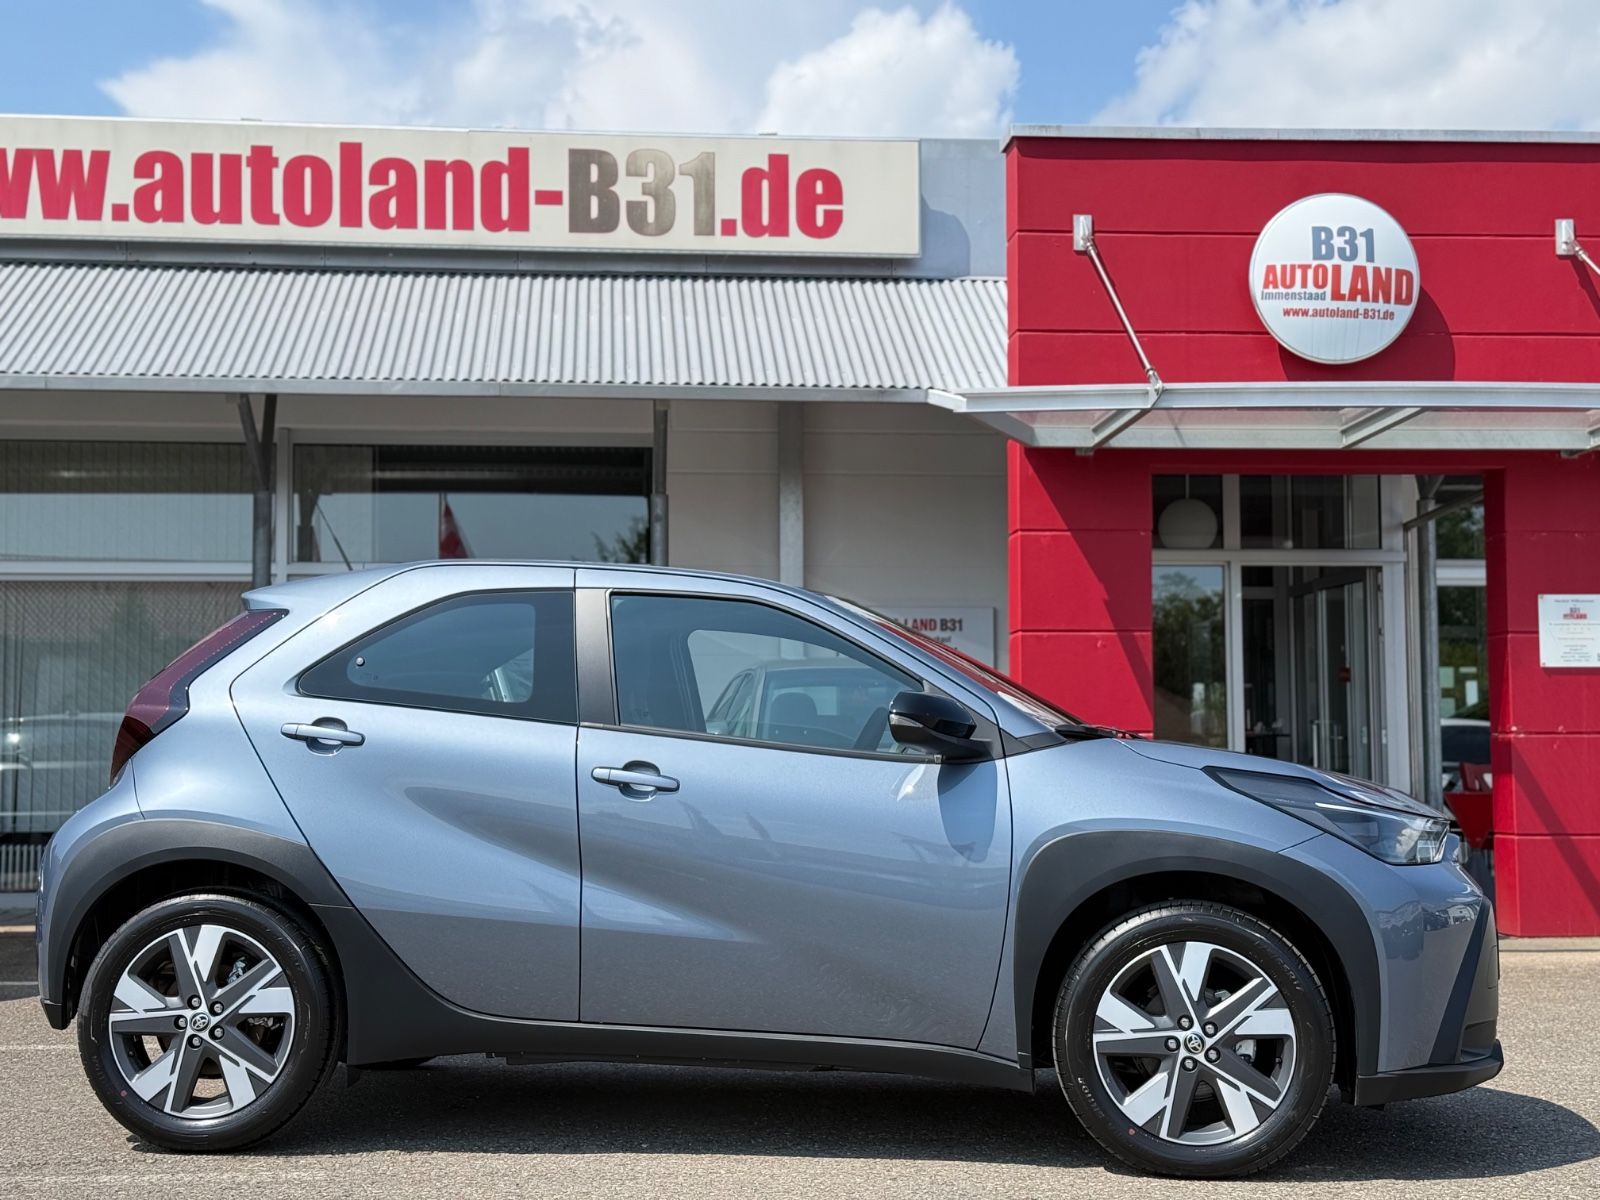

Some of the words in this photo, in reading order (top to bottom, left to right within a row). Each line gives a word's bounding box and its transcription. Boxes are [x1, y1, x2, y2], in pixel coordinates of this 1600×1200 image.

[1311, 226, 1375, 263] B31
[1261, 290, 1327, 301] Immenstaad
[1283, 306, 1395, 321] www.autoland-B31.de
[939, 617, 963, 632] B31
